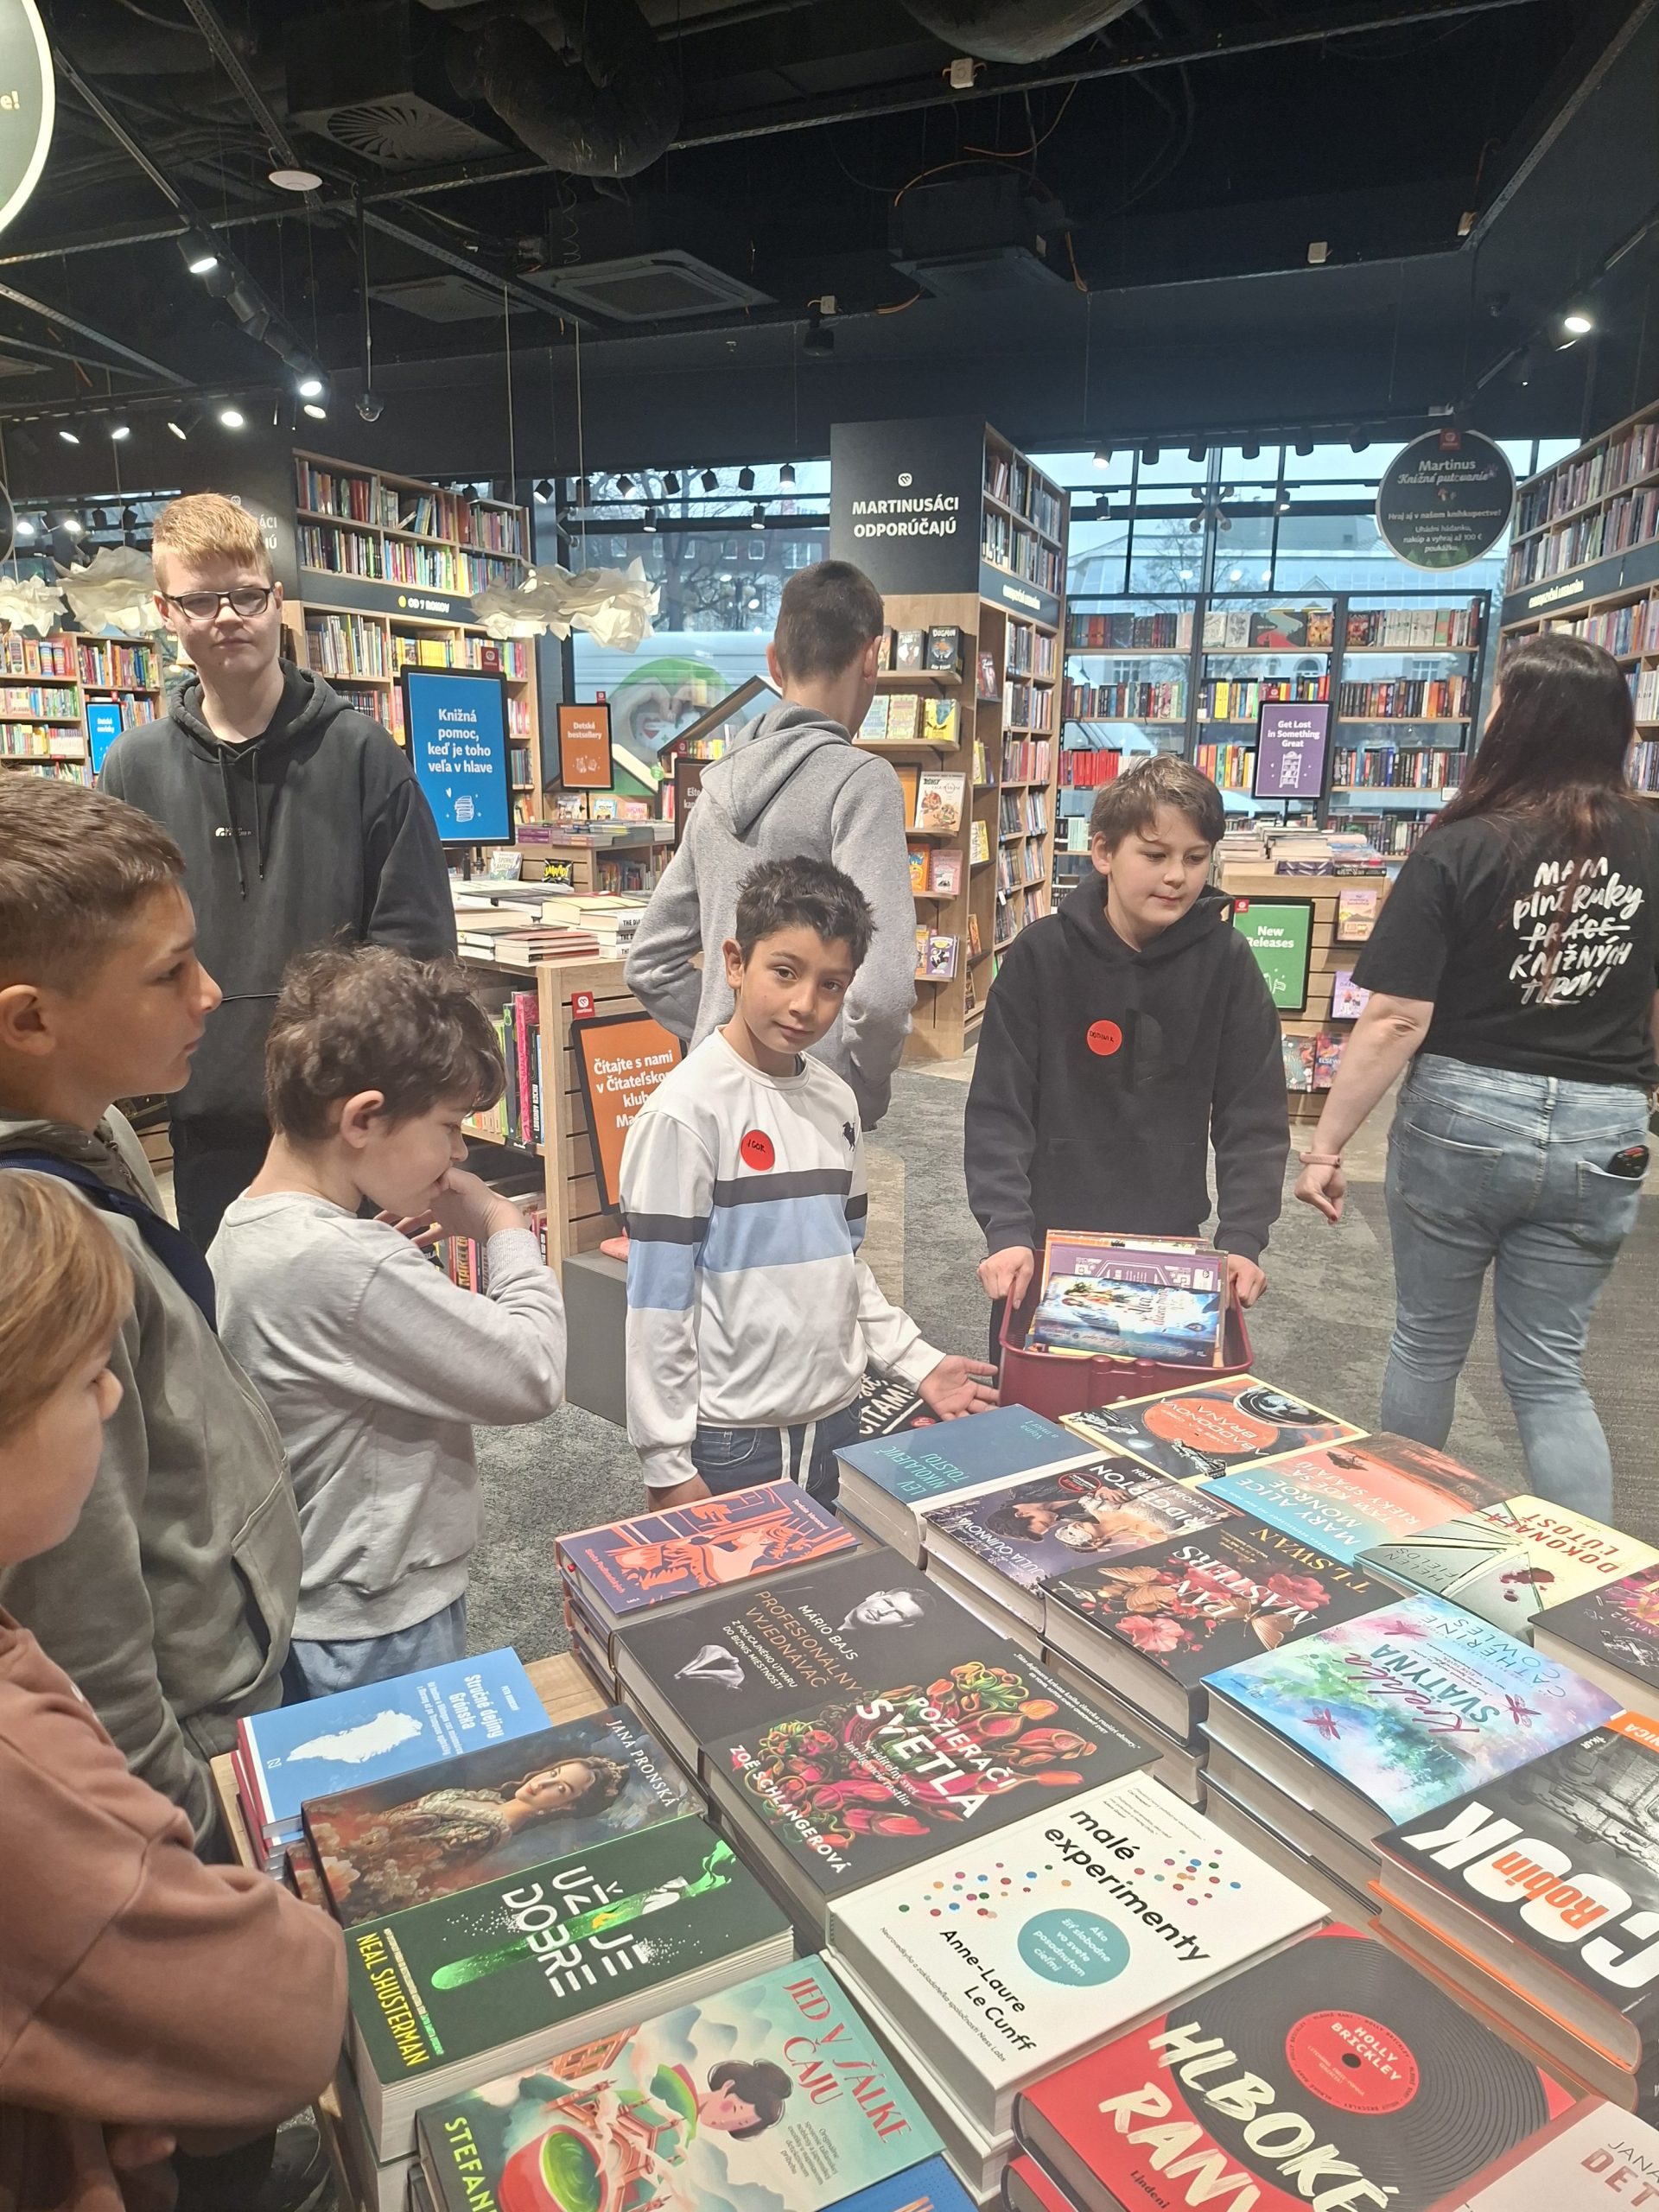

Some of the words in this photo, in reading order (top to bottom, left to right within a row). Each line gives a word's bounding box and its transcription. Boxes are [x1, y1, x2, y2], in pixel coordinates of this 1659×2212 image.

[1418, 459, 1477, 472] Martinus
[852, 494, 959, 515] MARTINUSÁCI
[854, 517, 957, 537] ODPORÚČAJÚ
[438, 709, 477, 722] Knižná
[438, 728, 480, 741] pomoc,
[1268, 729, 1275, 738] in
[1277, 730, 1320, 740] Something
[428, 742, 449, 756] keď
[452, 744, 463, 758] je
[465, 744, 491, 757] toho
[429, 760, 452, 772] veľa
[454, 763, 462, 773] v
[463, 760, 493, 773] hlave
[1247, 937, 1294, 949] Releases
[1257, 925, 1285, 938] New
[594, 1058, 632, 1077] Čítajte
[635, 1058, 642, 1068] s
[645, 1050, 674, 1068] nami
[596, 1083, 604, 1094] v
[747, 1139, 766, 1153] IGOR
[1159, 1397, 1269, 1458] ABADDONOVA
[919, 1452, 971, 1484] TOLSTOJ
[897, 1481, 926, 1497] LEV
[1090, 1465, 1207, 1529] RIDGERTON
[1236, 1478, 1292, 1508] ALICE
[1268, 1478, 1363, 1528] MONROE
[1368, 1495, 1422, 1526] RIEKY
[1249, 1528, 1335, 1573] SWAN
[1309, 1520, 1361, 1547] MARY
[1012, 1552, 1046, 1581] JULIA
[1334, 1566, 1355, 1581] L
[1385, 1553, 1442, 1583] HELEN
[1396, 1547, 1460, 1580] FIELDS
[1172, 1546, 1319, 1625] MASTERS
[1344, 1578, 1372, 1595] T
[722, 1625, 732, 1636] DO
[730, 1635, 752, 1656] BIZNIS
[746, 1606, 827, 1688] VYJEDNÁVAČ
[754, 1591, 862, 1693] PROFESIONÁLNY
[798, 1605, 833, 1636] MÁRIO
[828, 1635, 859, 1661] BAJS
[1455, 1617, 1560, 1681] COWLES
[1418, 1616, 1567, 1699] CATHERINE
[1370, 1643, 1503, 1725] SVÄTYŇA
[449, 1692, 477, 1730] Grónska
[464, 1674, 495, 1709] Stručné
[480, 1708, 505, 1739] dejiny
[855, 1698, 992, 1819] SVETLA
[906, 1695, 1018, 1789] POŽIERAČI
[605, 1719, 635, 1751] JANA
[629, 1747, 679, 1808] PRONSKÁ
[729, 1744, 761, 1773] ZOË
[751, 1769, 854, 1875] SCHLANGEROVÁ
[1068, 1808, 1141, 1861] malé
[1044, 1825, 1211, 1964] experimenty
[1491, 1851, 1610, 1930] Robin
[551, 1865, 624, 1916] UŽ
[591, 1933, 650, 1977] JE
[1090, 1926, 1109, 1942] Ako
[356, 1931, 389, 1970] NEAL
[501, 1884, 599, 1999] DOBRE
[1033, 1930, 1085, 1977] posadnutom
[1057, 1931, 1068, 1942] vo
[1066, 1941, 1090, 1962] svete
[1072, 1929, 1111, 1962] slobodne
[939, 1929, 1026, 2012] Anne-Laure
[370, 1967, 430, 2067] SHUSTERMAN
[784, 1975, 833, 2023] JED
[963, 1985, 987, 2007] Le
[984, 2005, 1038, 2051] Cunff
[821, 2022, 854, 2047] V
[976, 2031, 993, 2048] Ness
[991, 2045, 1007, 2063] Labs
[1331, 2021, 1402, 2082] BRICKLEY
[1354, 2025, 1400, 2063] HOLLY
[782, 2035, 845, 2109] ČAJU
[833, 2057, 916, 2145] ŠÁLKE
[1148, 2021, 1401, 2212] HLBOKÉ
[1129, 2170, 1171, 2209] Lindeni
